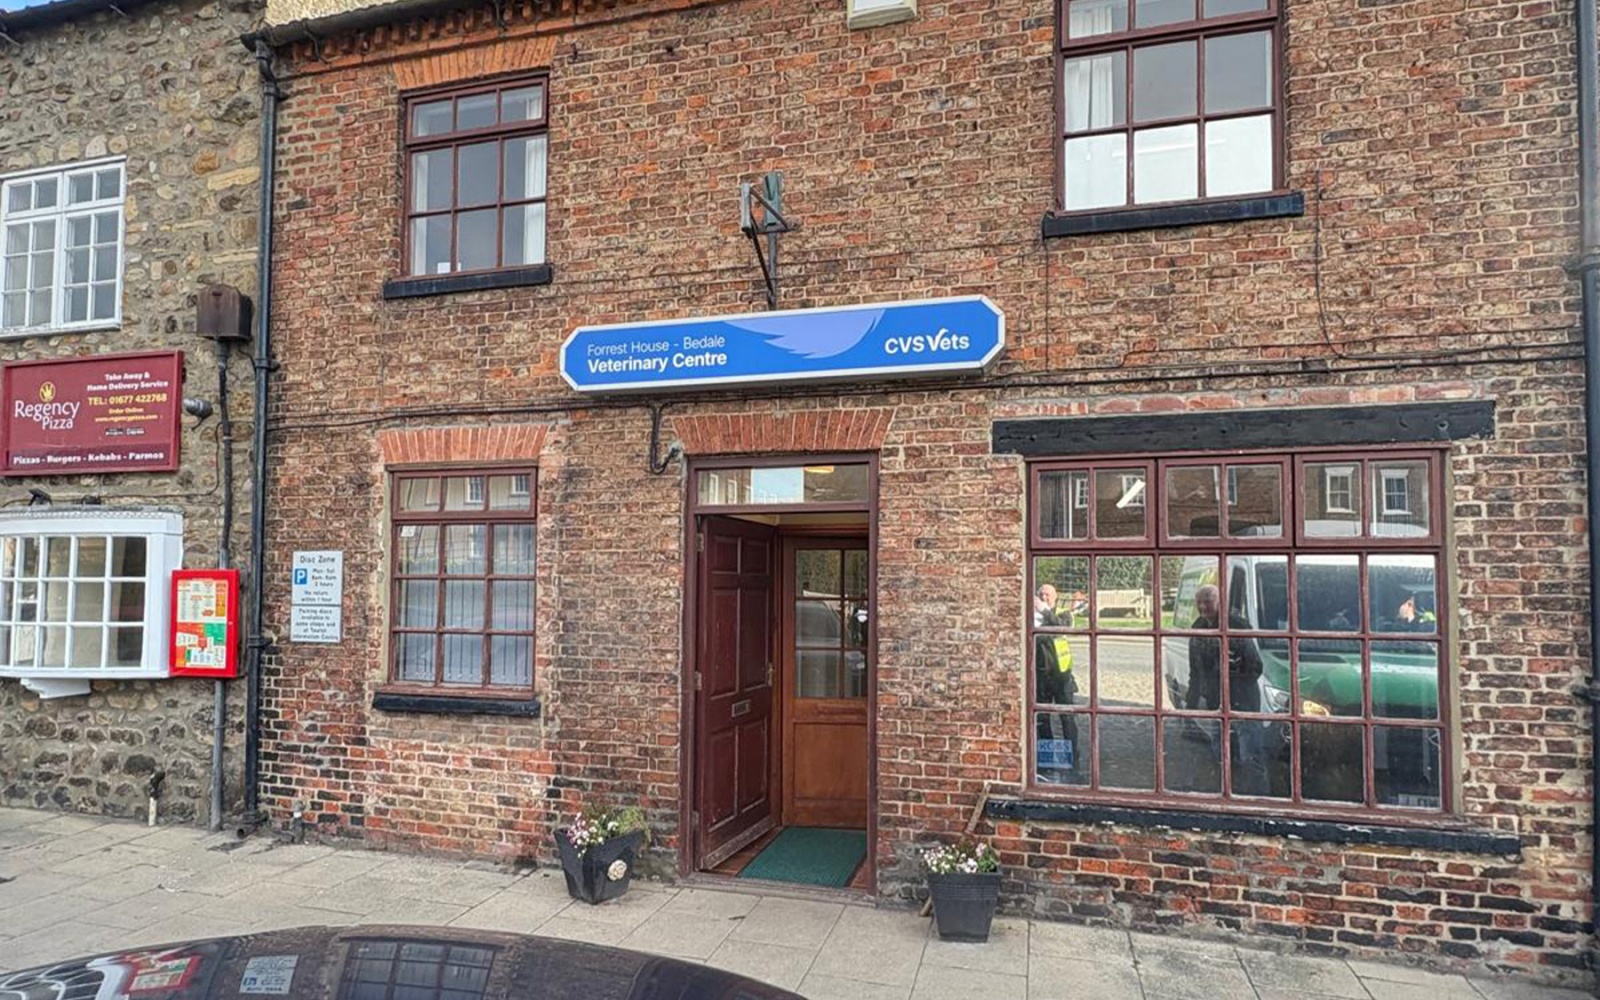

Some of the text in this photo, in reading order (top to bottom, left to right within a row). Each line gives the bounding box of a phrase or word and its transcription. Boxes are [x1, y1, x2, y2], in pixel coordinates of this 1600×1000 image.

[587, 343, 628, 356] Forrest
[631, 340, 670, 353] House
[683, 334, 726, 350] Bedale
[588, 351, 728, 374] Veterinary Centre
[123, 372, 143, 381] Away
[108, 382, 139, 391] Delivery
[140, 380, 169, 389] Service
[88, 396, 107, 406] TEL:
[108, 394, 134, 405] 01677
[14, 400, 80, 422] Regency
[42, 416, 74, 430] Pizza
[13, 455, 41, 465] Pizzas
[46, 454, 82, 465] Burgers
[87, 453, 122, 463] Kebabs
[128, 452, 165, 461] Parmos
[300, 555, 336, 564] Disc Zone
